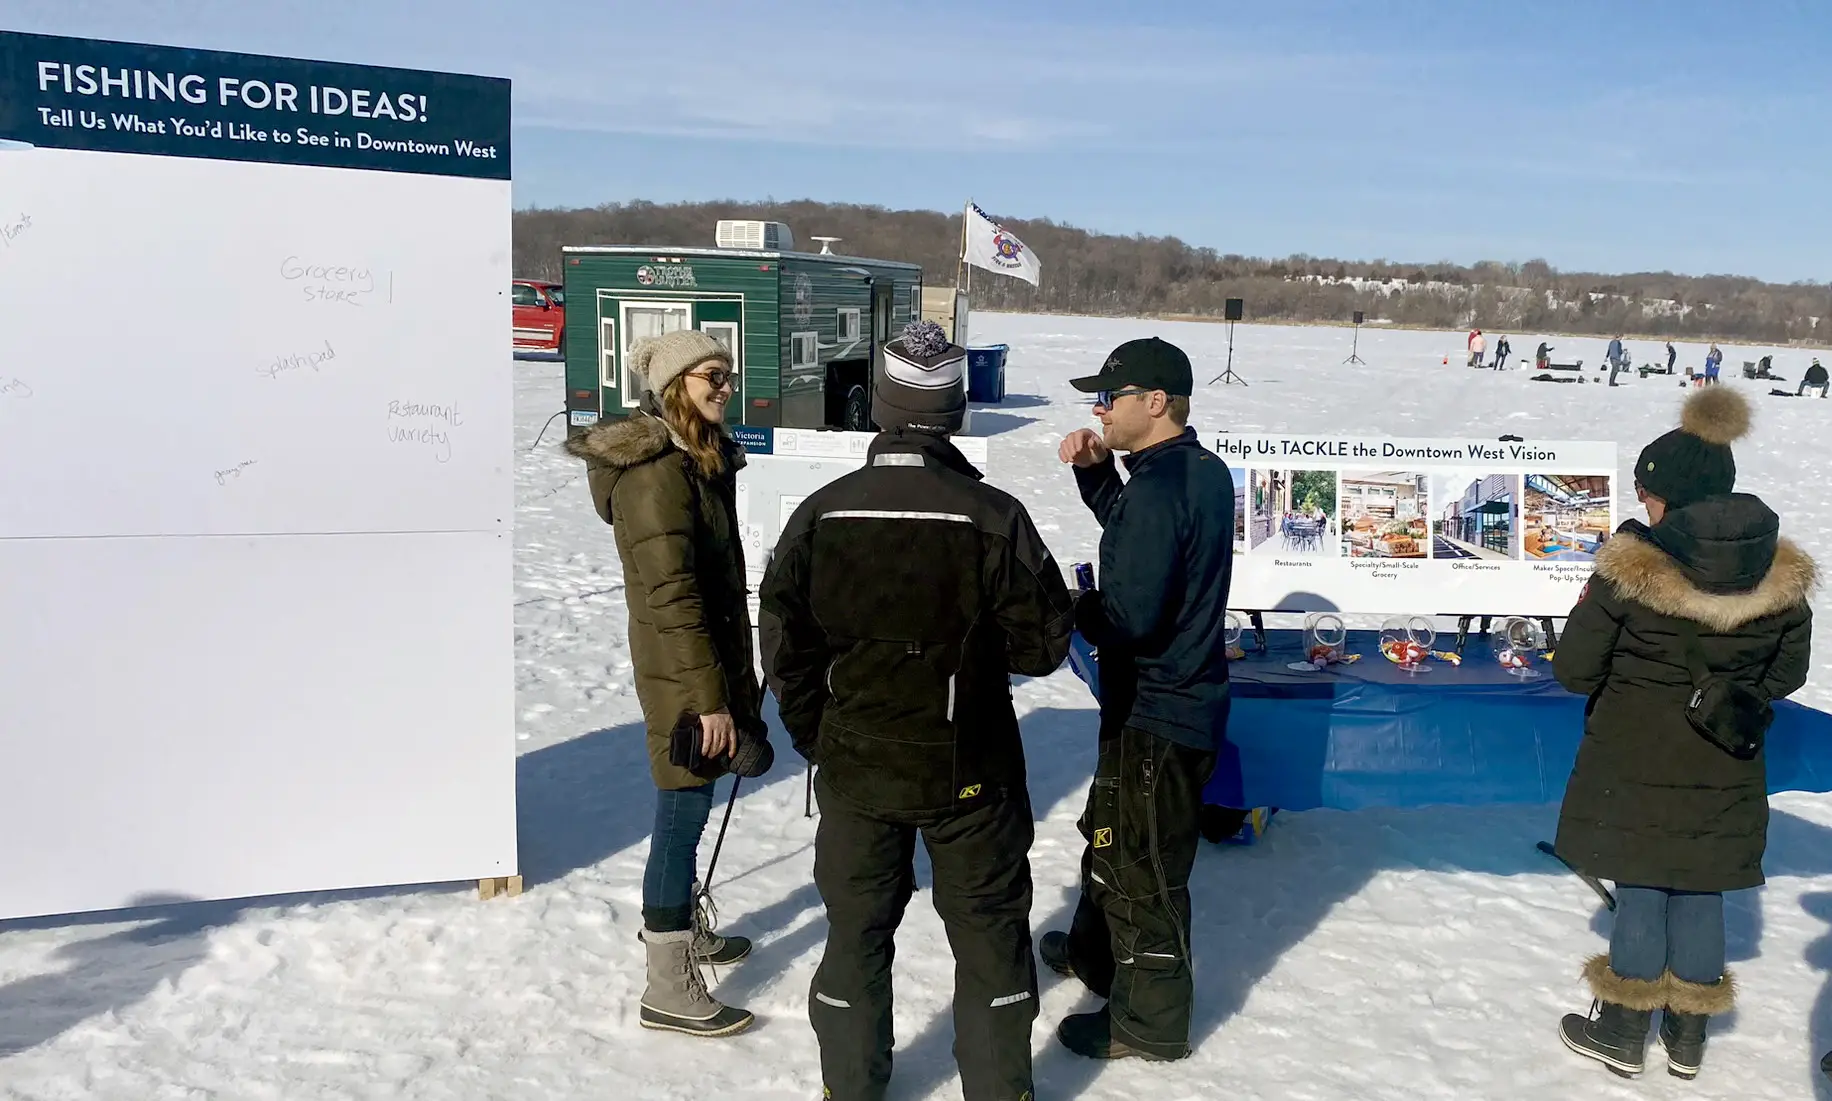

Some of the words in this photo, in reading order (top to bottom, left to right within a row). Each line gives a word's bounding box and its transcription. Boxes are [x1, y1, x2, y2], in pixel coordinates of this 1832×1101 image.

[38, 61, 207, 104] FISHING
[219, 77, 298, 112] FOR
[310, 86, 428, 123] IDEAS!
[38, 107, 73, 127] Tell
[80, 110, 107, 129] Us
[111, 112, 167, 134] What
[170, 117, 222, 138] You’d
[229, 122, 268, 141] Like
[273, 129, 291, 143] to
[297, 127, 329, 146] See
[335, 131, 351, 148] in
[357, 132, 449, 155] Downtown
[454, 140, 497, 159] West
[281, 256, 374, 292] Grocery
[388, 399, 463, 426] Restaurant
[735, 431, 765, 440] Victoria
[1216, 438, 1251, 459] Help
[1257, 440, 1276, 454] Us
[1281, 440, 1348, 456] TACKLE
[1353, 442, 1377, 457] the
[1382, 442, 1462, 459] Downtown
[1467, 444, 1504, 460] West
[1509, 445, 1556, 460] Vision
[1350, 561, 1419, 570] Specialty/Small-Scale
[1452, 563, 1501, 571] Office/Services
[1533, 564, 1554, 572] Maker
[1555, 564, 1596, 573] Space/Incub
[1371, 571, 1398, 580] Grocery
[1549, 574, 1574, 583] Pop-Up
